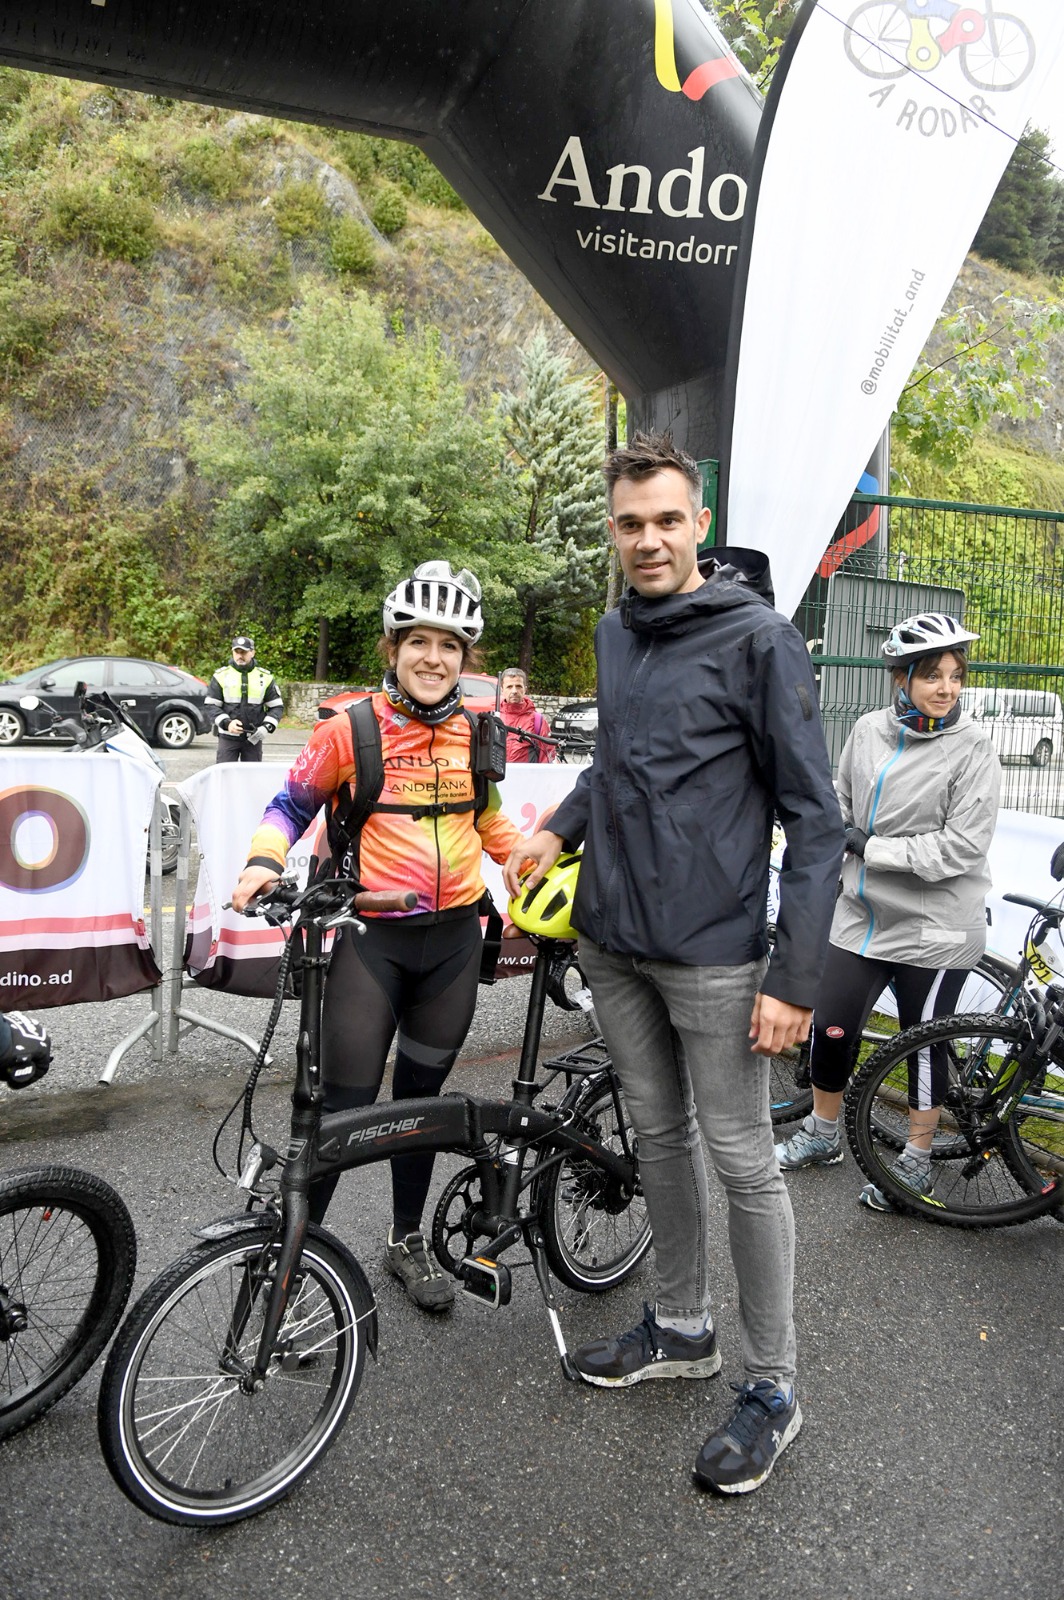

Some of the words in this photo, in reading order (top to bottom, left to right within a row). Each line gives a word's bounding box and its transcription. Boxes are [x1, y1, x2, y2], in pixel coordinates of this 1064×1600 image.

[868, 83, 896, 108] A
[896, 94, 996, 138] RODAR
[537, 135, 748, 222] Ando
[576, 225, 738, 265] visitandorr
[860, 268, 926, 395] @mobilitat_and
[391, 780, 468, 793] ANDBANK
